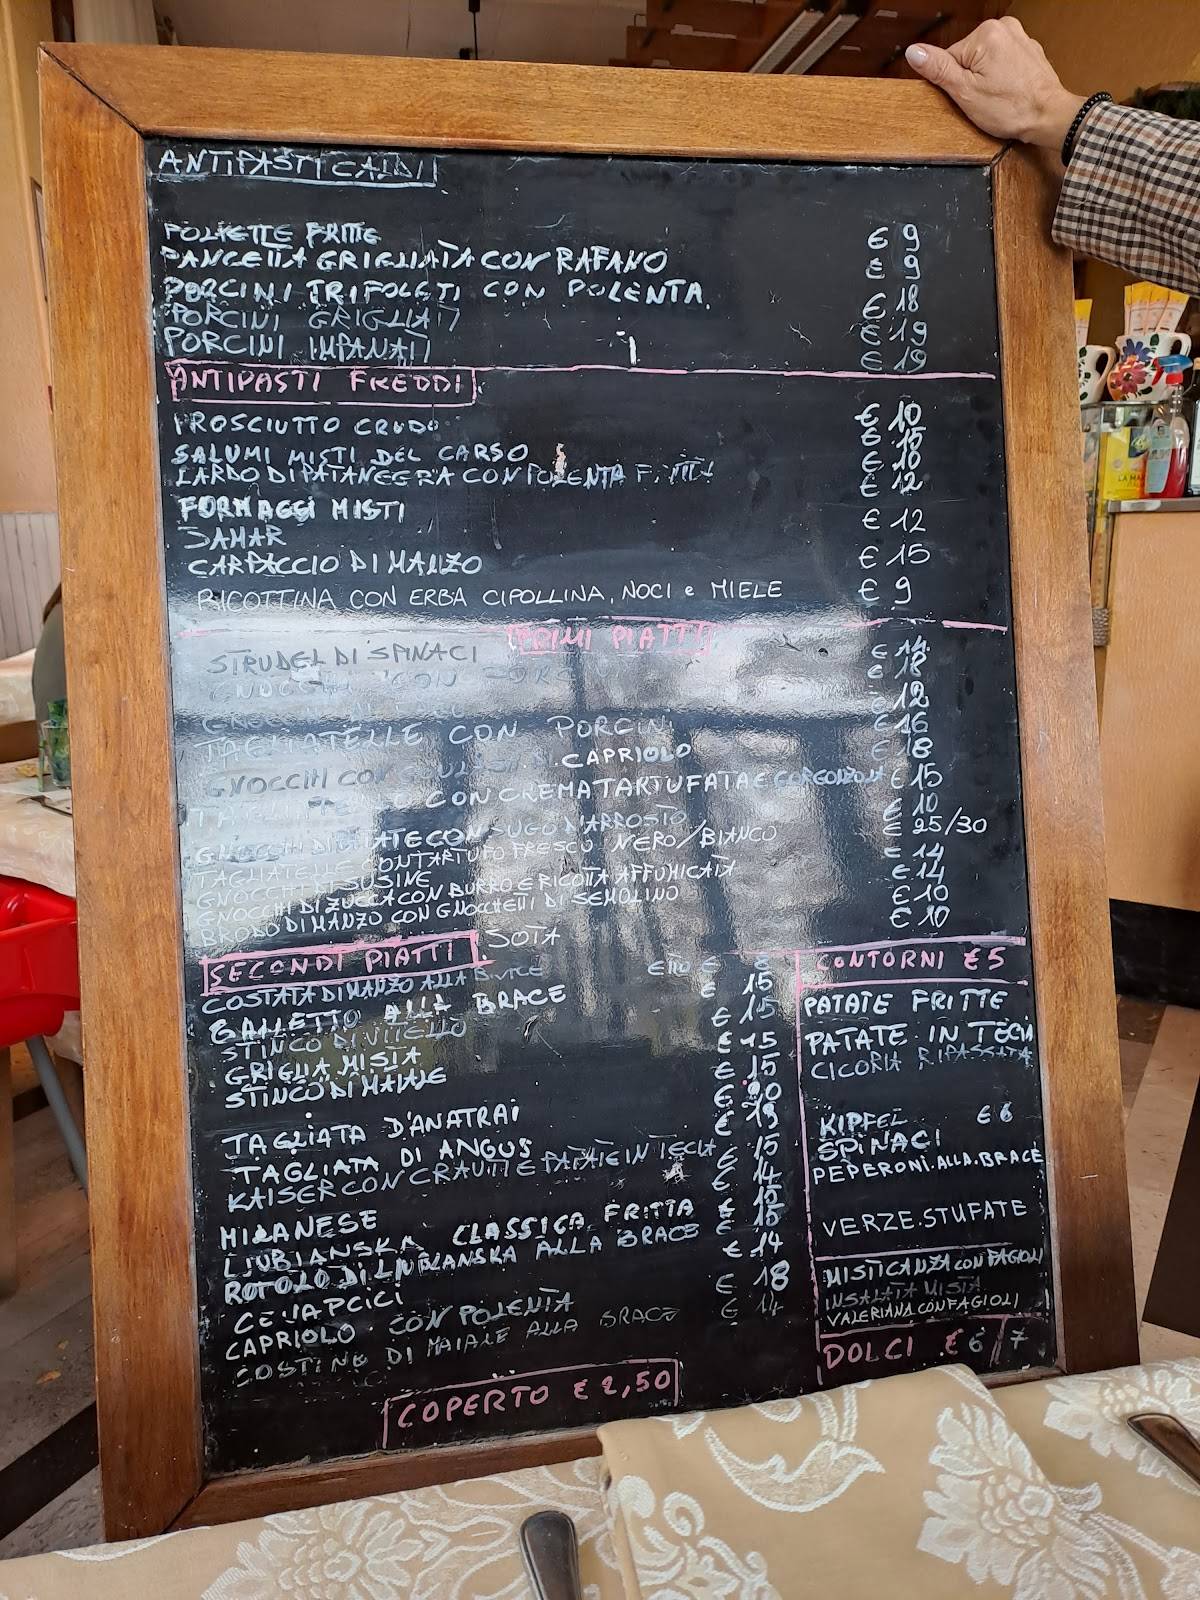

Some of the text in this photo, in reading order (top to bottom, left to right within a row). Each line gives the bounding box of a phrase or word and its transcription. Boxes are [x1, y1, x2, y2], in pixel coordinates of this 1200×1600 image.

[159, 149, 321, 179] ANTIPASTI
[902, 224, 920, 251] 9
[160, 240, 668, 274] PANCETTA GRIGLIATA CON RAFANO
[903, 255, 921, 280] 9
[164, 276, 702, 304] PORCINI CON POLENTA
[895, 284, 919, 312] 18
[170, 302, 281, 332] PORCINI
[164, 327, 431, 363] PORCINI IMPANATI
[889, 318, 927, 347] 19
[172, 367, 462, 394] ANTIPASTI FREDDI
[174, 411, 440, 436] PROSCIUTTO CRUDO
[888, 400, 923, 433] 10
[896, 426, 927, 451] 15
[171, 442, 530, 466] SALUMI MISTI DEL CARSO
[892, 451, 922, 471] 10
[175, 463, 261, 488] LARDO
[268, 468, 295, 485] DI
[462, 467, 522, 485] CON
[178, 496, 406, 525] FORMAGGI MISTI
[890, 508, 927, 534] 12
[188, 549, 484, 577] CARPACCIO DI MANZO
[886, 543, 931, 566] 15
[196, 588, 334, 613] RICOTTINA
[350, 586, 399, 613] CON
[409, 590, 468, 607] ERBA
[622, 580, 673, 600] NOCI
[711, 578, 783, 600] MIELE
[894, 576, 913, 605] 9
[207, 649, 325, 676] STRUDEL
[449, 721, 517, 745] CON
[561, 743, 691, 768] CAPRIOLO
[911, 763, 942, 788] 15
[424, 789, 492, 809] CON
[912, 792, 938, 816] 10
[916, 860, 944, 883] 14
[326, 890, 395, 912] ZUCCA
[398, 886, 443, 905] CON
[449, 878, 512, 896] BURRO
[914, 884, 949, 901] 10
[312, 910, 382, 934] MANZO
[391, 905, 430, 923] CON
[918, 905, 950, 928] 10
[210, 939, 453, 987] SECONDI PIATTI
[817, 950, 944, 971] CONTORNI
[742, 971, 773, 995] 15
[201, 986, 315, 1015] COSTATA
[472, 984, 566, 1014] BRACE
[739, 994, 778, 1024] 15
[804, 988, 1008, 1016] PATATE FRITTE
[740, 1032, 777, 1049] 15
[805, 1023, 958, 1056] PATATE IN
[225, 1057, 330, 1085] GRIGLIA
[747, 1052, 780, 1080] 15
[811, 1051, 901, 1081] CICORIA
[225, 1082, 325, 1108] STINCO
[820, 1108, 907, 1137] KIPFEL
[222, 1125, 366, 1154] TAGLIATA
[754, 1132, 780, 1160] 15
[818, 1129, 940, 1162] SPINACI
[234, 1138, 532, 1184] TAGLIATA DI ANGUS
[753, 1155, 782, 1184] 14
[228, 1171, 403, 1213] KAISER CON
[453, 1212, 583, 1245] CLASSICA
[604, 1199, 694, 1222] FRITTA
[536, 1235, 602, 1260] ALLA
[750, 1231, 783, 1257] 14
[753, 1260, 790, 1291] 18
[226, 1286, 574, 1360] CAPRIOLO CON POLENTA
[827, 1293, 1018, 1326] VALERIANA CON FAGIOLI
[526, 1318, 579, 1338] ALLA
[823, 1336, 913, 1369] DOLCI
[398, 1386, 549, 1428] COPERTO
